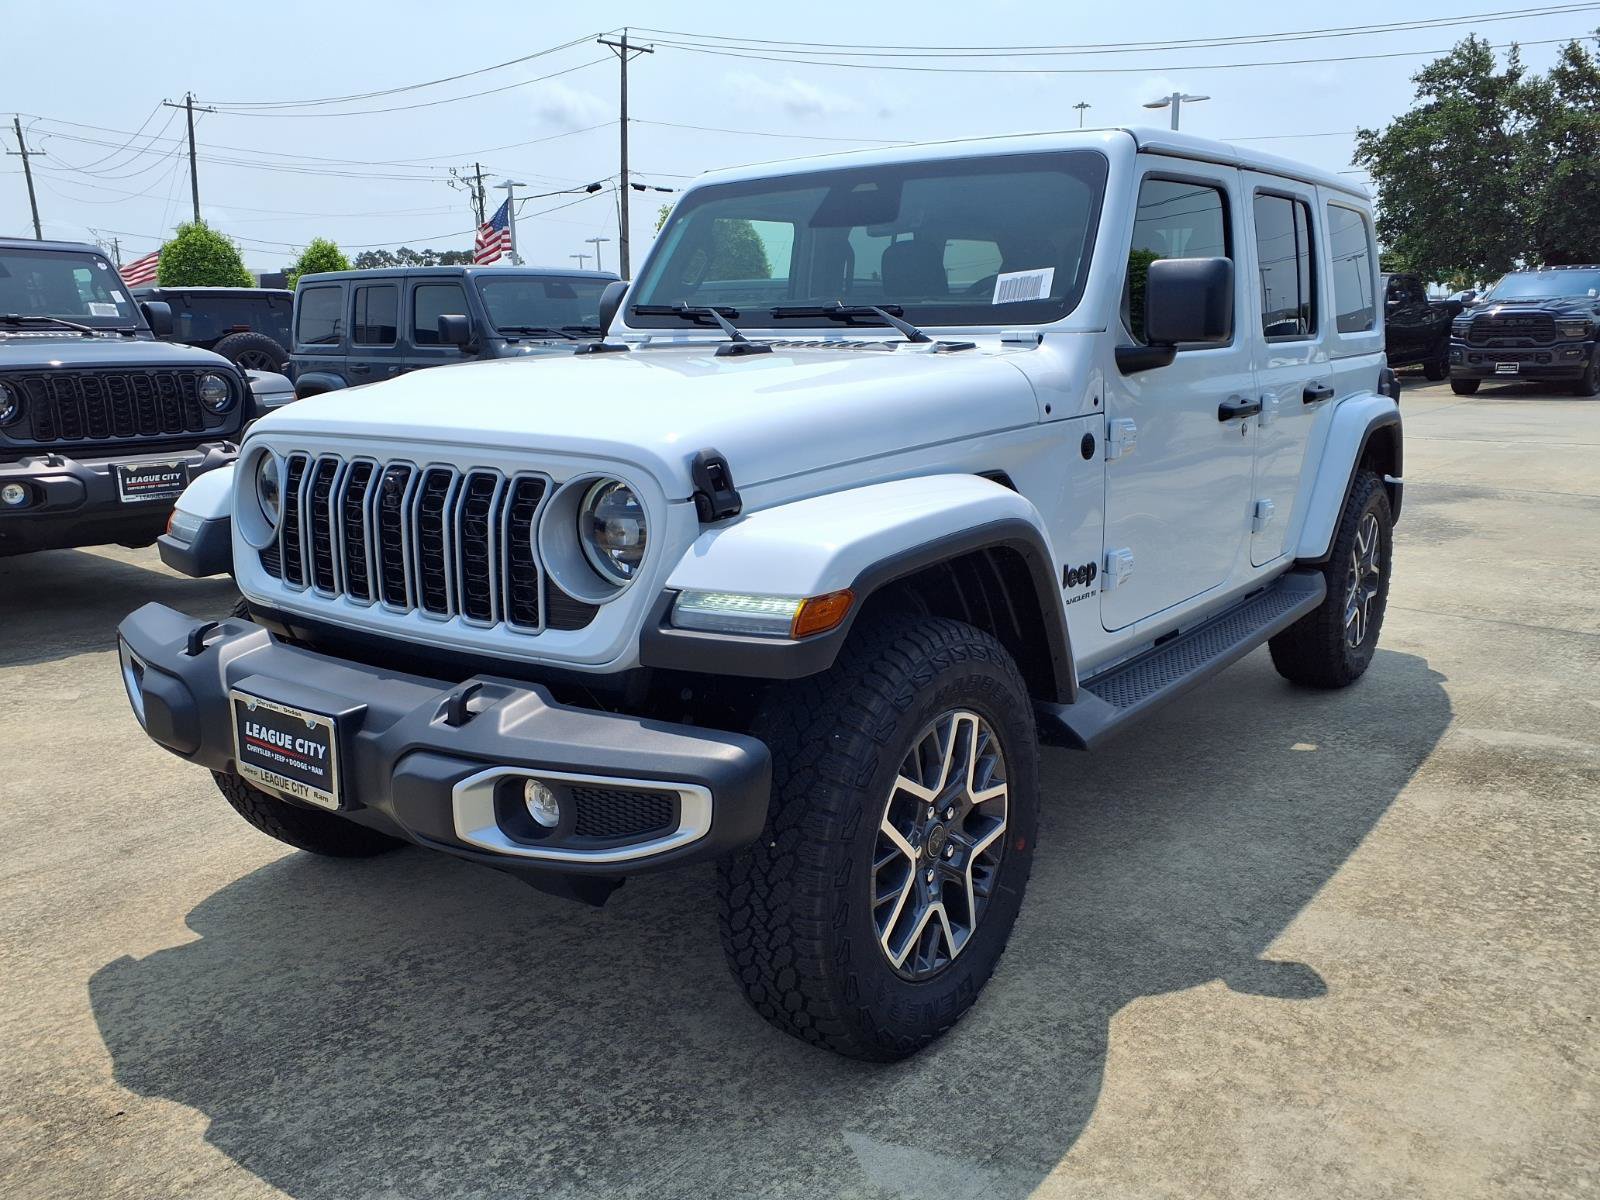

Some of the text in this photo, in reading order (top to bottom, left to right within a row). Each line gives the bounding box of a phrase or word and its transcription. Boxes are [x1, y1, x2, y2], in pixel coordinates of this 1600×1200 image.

[126, 474, 161, 484] LEAGUE
[1063, 561, 1097, 589] Jeep
[256, 699, 302, 717] Chrysler Dodge
[245, 721, 326, 760] LEAGUE CITY
[247, 744, 324, 776] CHRYSLER JEEP DODGE RAM
[260, 770, 289, 790] LEAGUE
[291, 783, 309, 797] CITY
[313, 791, 329, 803] Ram
